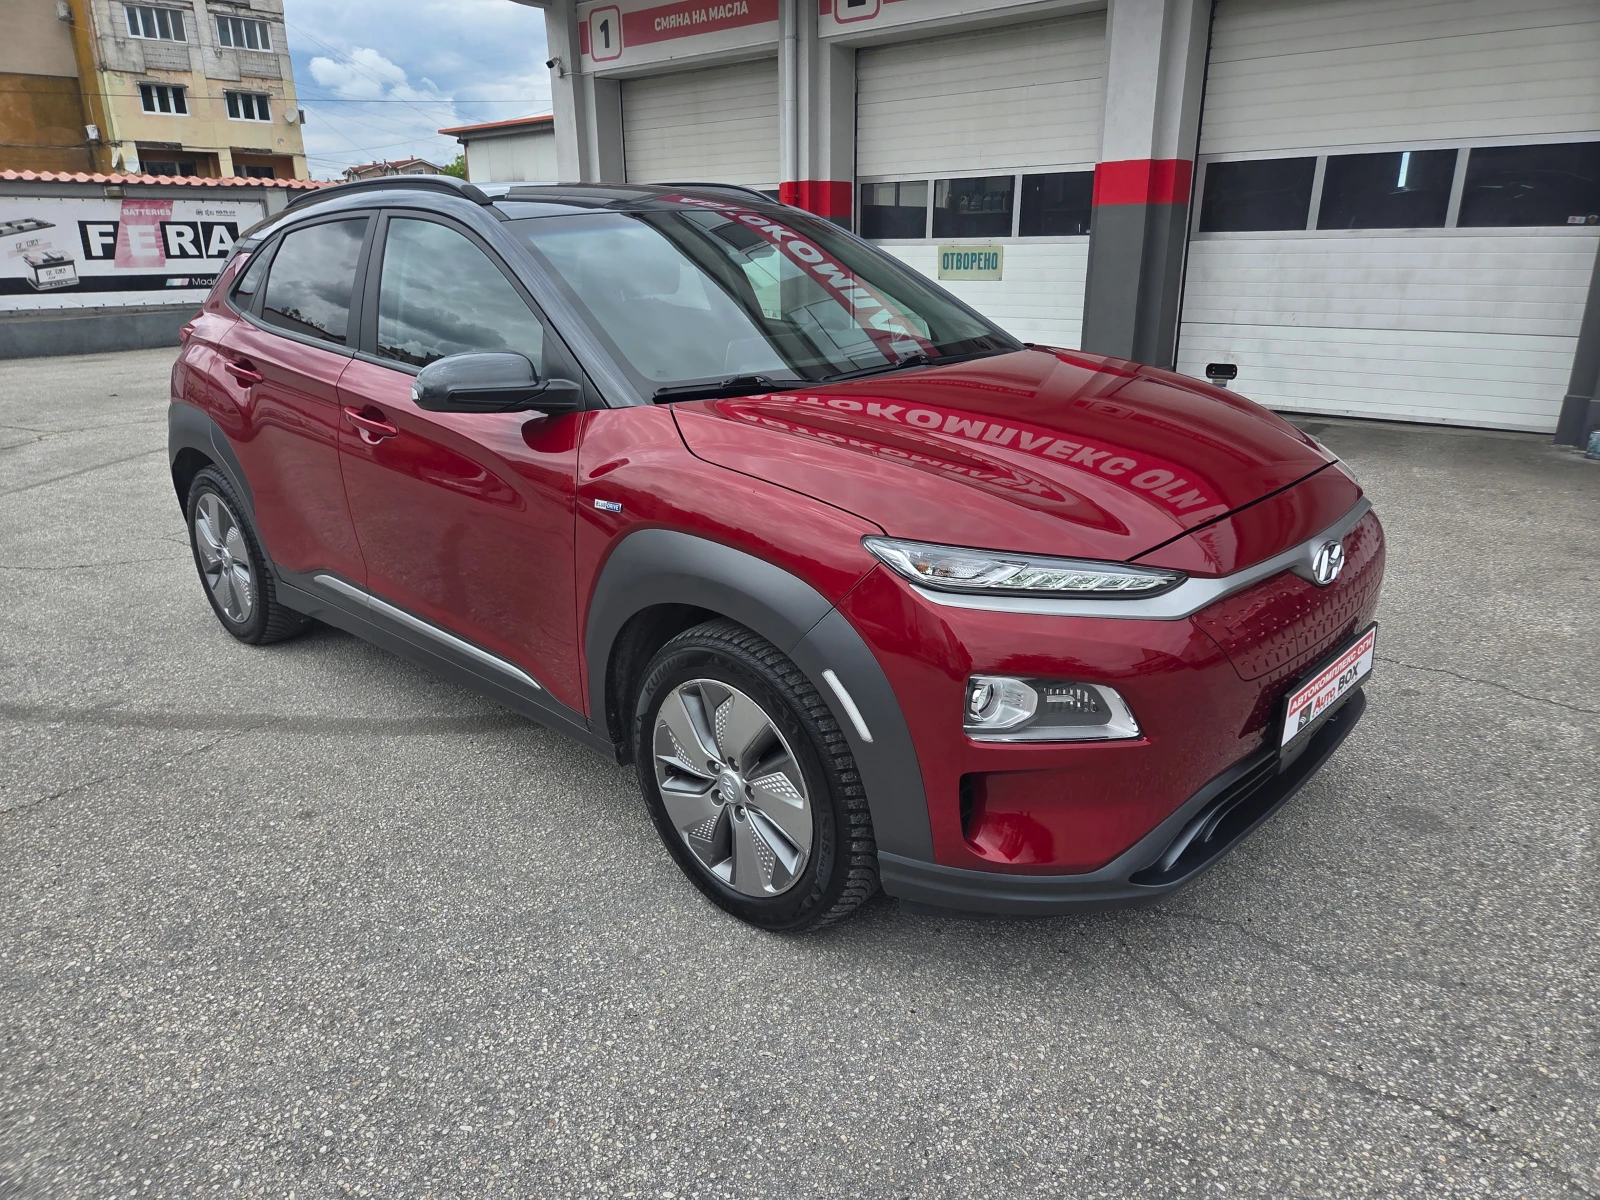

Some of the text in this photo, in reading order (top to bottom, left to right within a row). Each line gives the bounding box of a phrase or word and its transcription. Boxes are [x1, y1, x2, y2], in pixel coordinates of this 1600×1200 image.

[654, 1, 749, 31] СМЯНА НА МАСЛА
[599, 18, 611, 48] 1
[122, 208, 172, 216] BATTERIES
[85, 224, 235, 257] FERA
[943, 252, 998, 270] ОТВОРЕНО
[1338, 661, 1359, 692] BOX
